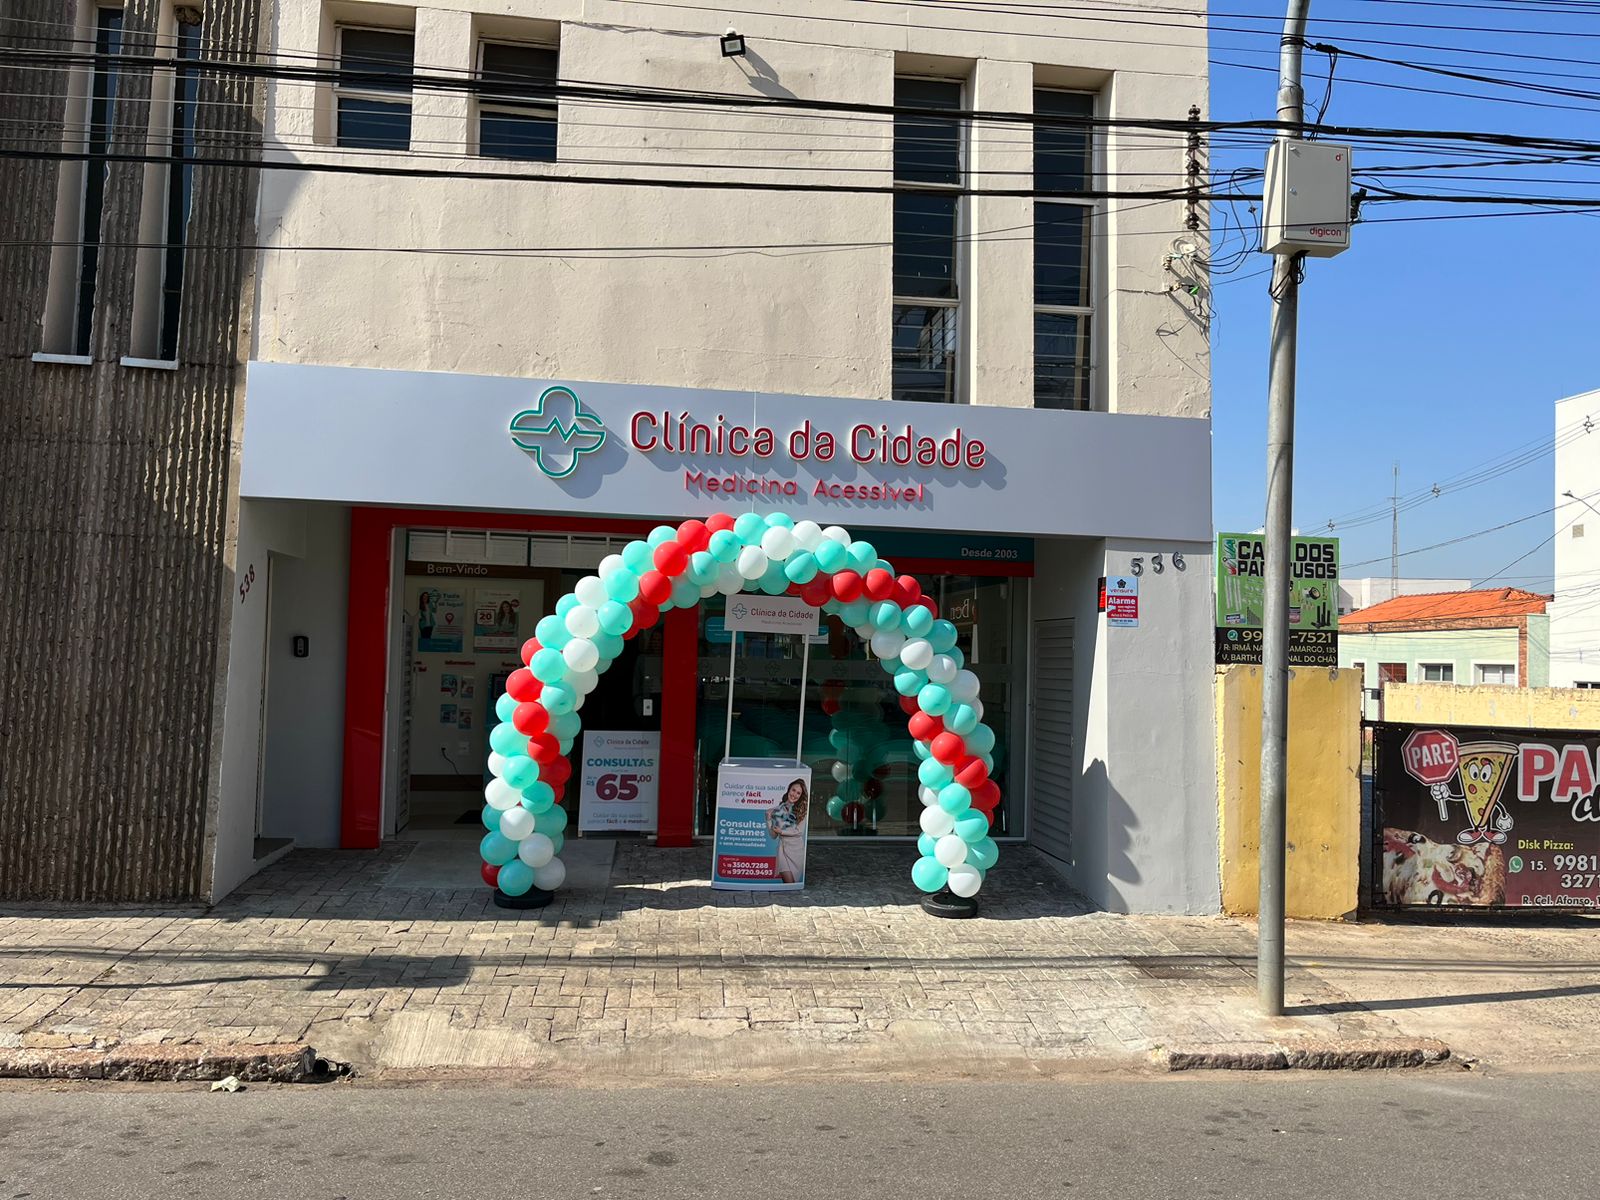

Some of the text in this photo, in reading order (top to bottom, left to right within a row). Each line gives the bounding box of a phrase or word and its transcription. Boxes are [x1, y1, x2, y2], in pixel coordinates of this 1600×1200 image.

[1309, 227, 1342, 238] digicon
[630, 410, 987, 470] Clínica da Cidade
[684, 470, 925, 502] Medicina Acessível
[961, 547, 1018, 559] Desde 2003
[1238, 540, 1334, 562] CA DOS
[427, 563, 488, 575] Bem-Vindo
[1130, 551, 1187, 577] 536
[240, 563, 255, 604] 538
[1108, 597, 1136, 605] Alarme
[750, 608, 814, 620] Clínica da Cidade
[1232, 643, 1252, 651] IRMÃ
[1289, 645, 1325, 654] AMARGO,
[1304, 655, 1316, 663] DO
[1411, 741, 1453, 769] PARE
[586, 758, 654, 767] CONSULTAS
[745, 790, 762, 798] fácil
[719, 819, 767, 828] Consultas
[728, 828, 765, 836] Exames
[1518, 839, 1574, 850] Disk Pizza:
[1530, 854, 1597, 871] 15. 9981
[1522, 895, 1532, 905] R.
[1535, 895, 1553, 905] Cel.
[1556, 895, 1594, 906] Afonso,
